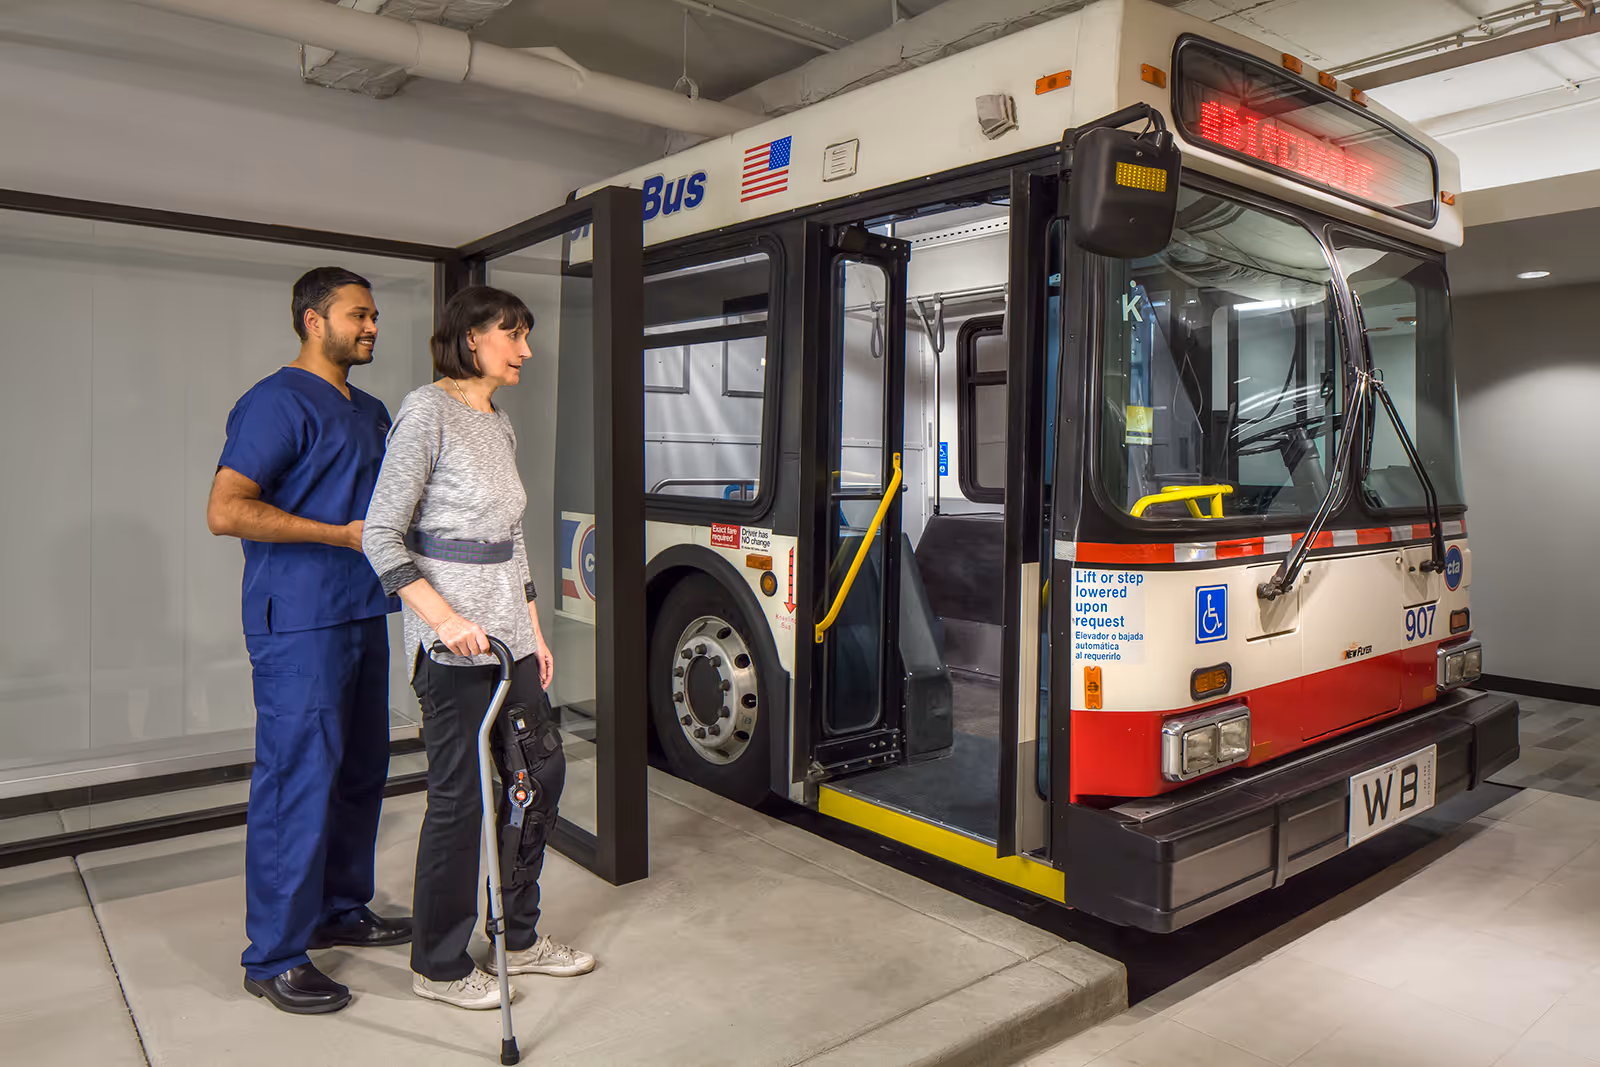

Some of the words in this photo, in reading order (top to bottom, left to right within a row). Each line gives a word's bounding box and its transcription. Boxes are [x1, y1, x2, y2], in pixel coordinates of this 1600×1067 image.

[642, 170, 708, 222] Bus
[1121, 293, 1143, 321] K
[712, 525, 727, 534] Exact
[727, 527, 738, 535] fare
[742, 528, 758, 537] Driver
[758, 530, 769, 538] has
[712, 534, 734, 542] required
[742, 536, 750, 544] NO
[751, 538, 771, 548] change
[1447, 561, 1460, 575] cta
[1076, 570, 1096, 583] Lift
[1100, 574, 1113, 583] or
[1117, 572, 1144, 586] step
[1076, 585, 1127, 598] lowered
[1075, 602, 1108, 615] upon
[1075, 615, 1125, 629] request
[1405, 604, 1436, 641] 907
[1075, 631, 1109, 640] Elevador
[1118, 632, 1144, 641] bajada
[1075, 642, 1119, 650] automática
[1084, 652, 1121, 661] requerirlo
